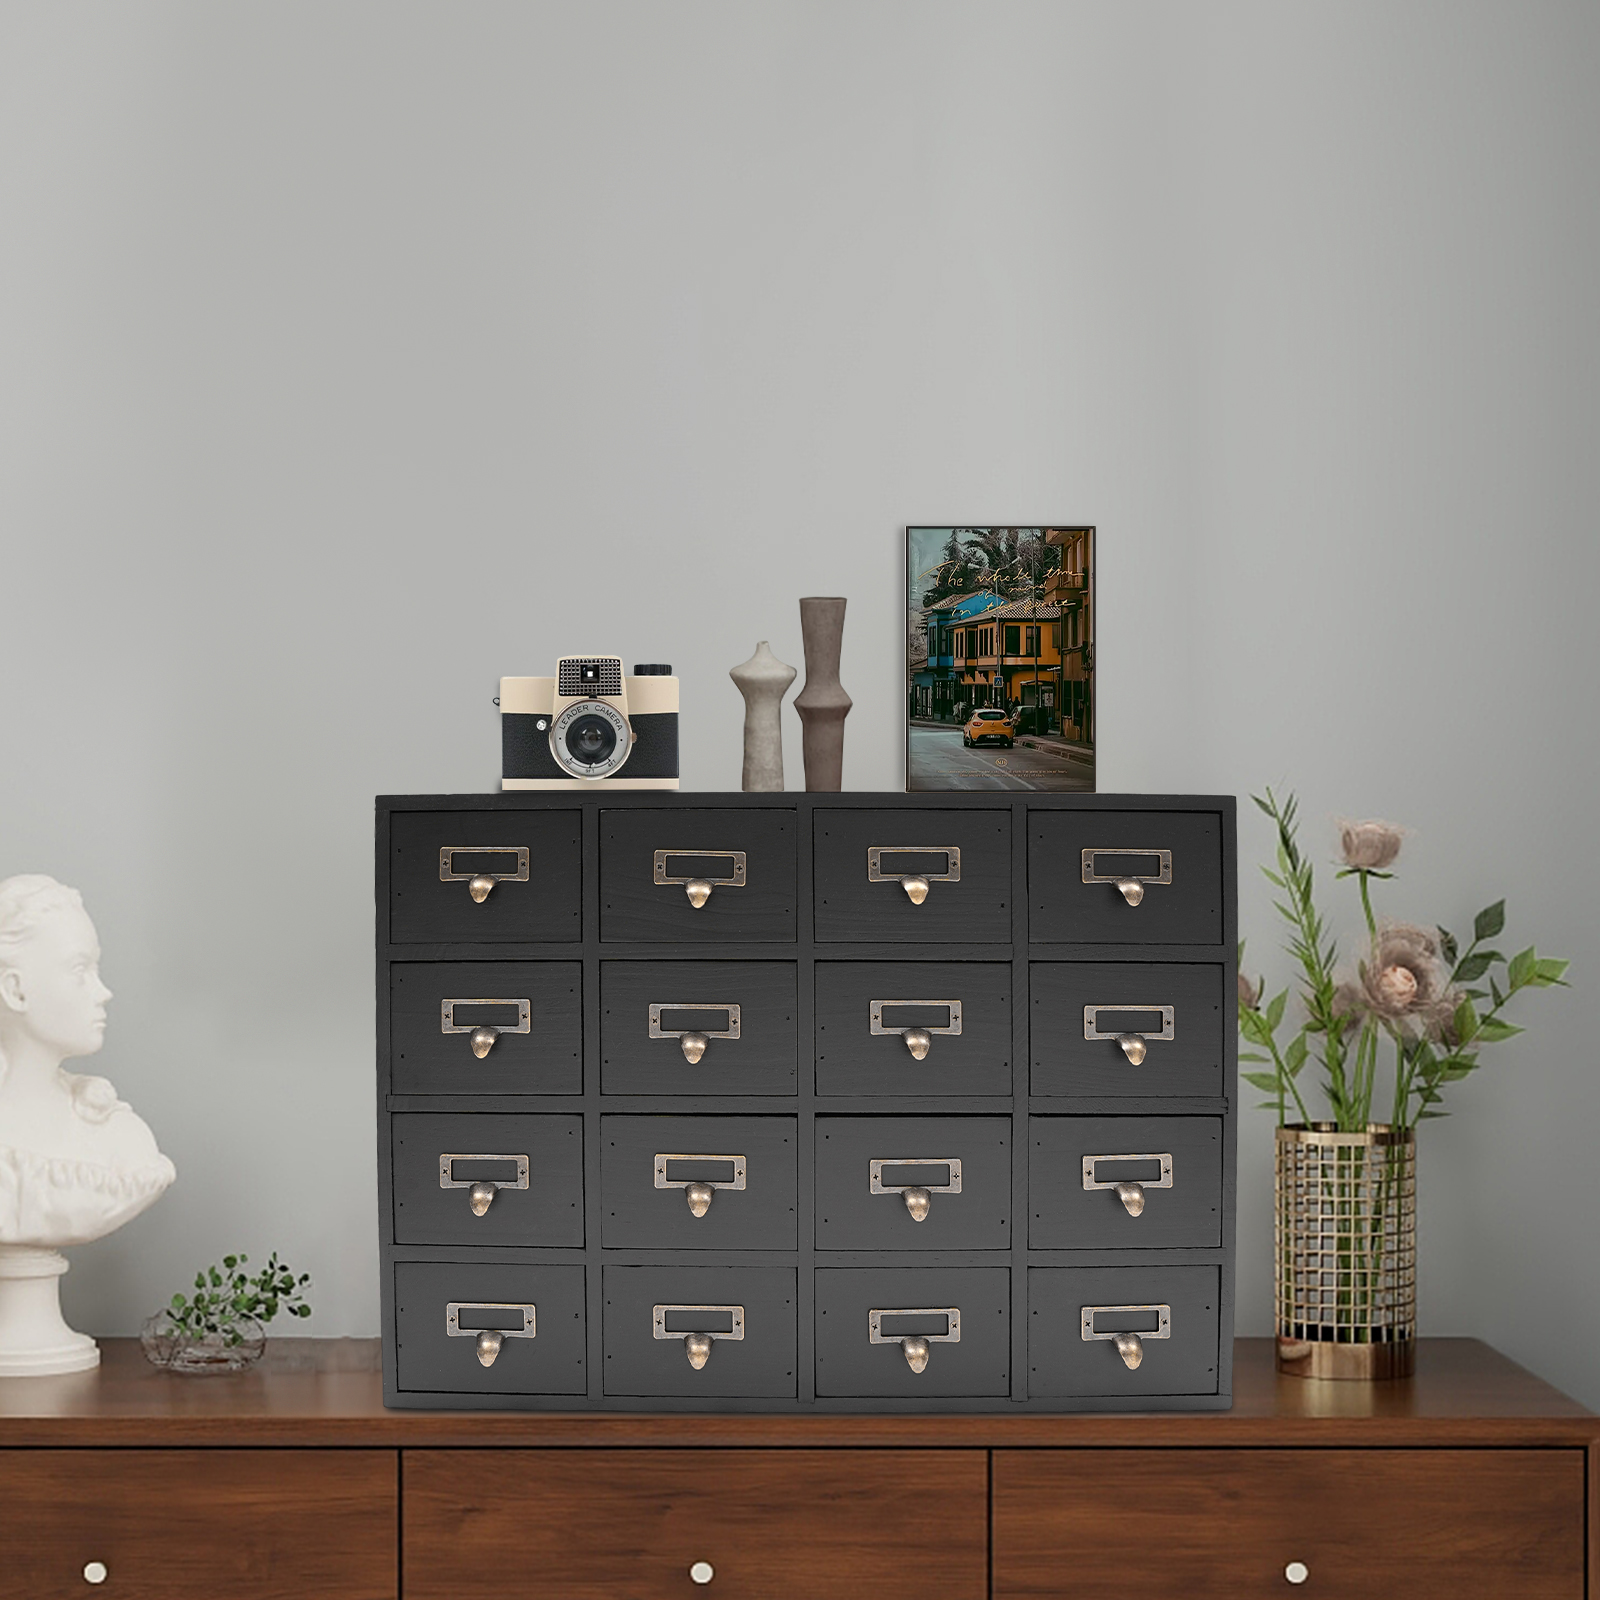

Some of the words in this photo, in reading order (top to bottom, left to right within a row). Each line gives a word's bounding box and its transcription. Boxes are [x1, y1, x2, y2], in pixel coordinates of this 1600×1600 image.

[918, 560, 964, 587] The
[976, 567, 1031, 583] whole
[559, 704, 589, 731] LEADER
[594, 704, 623, 731] CAMERA
